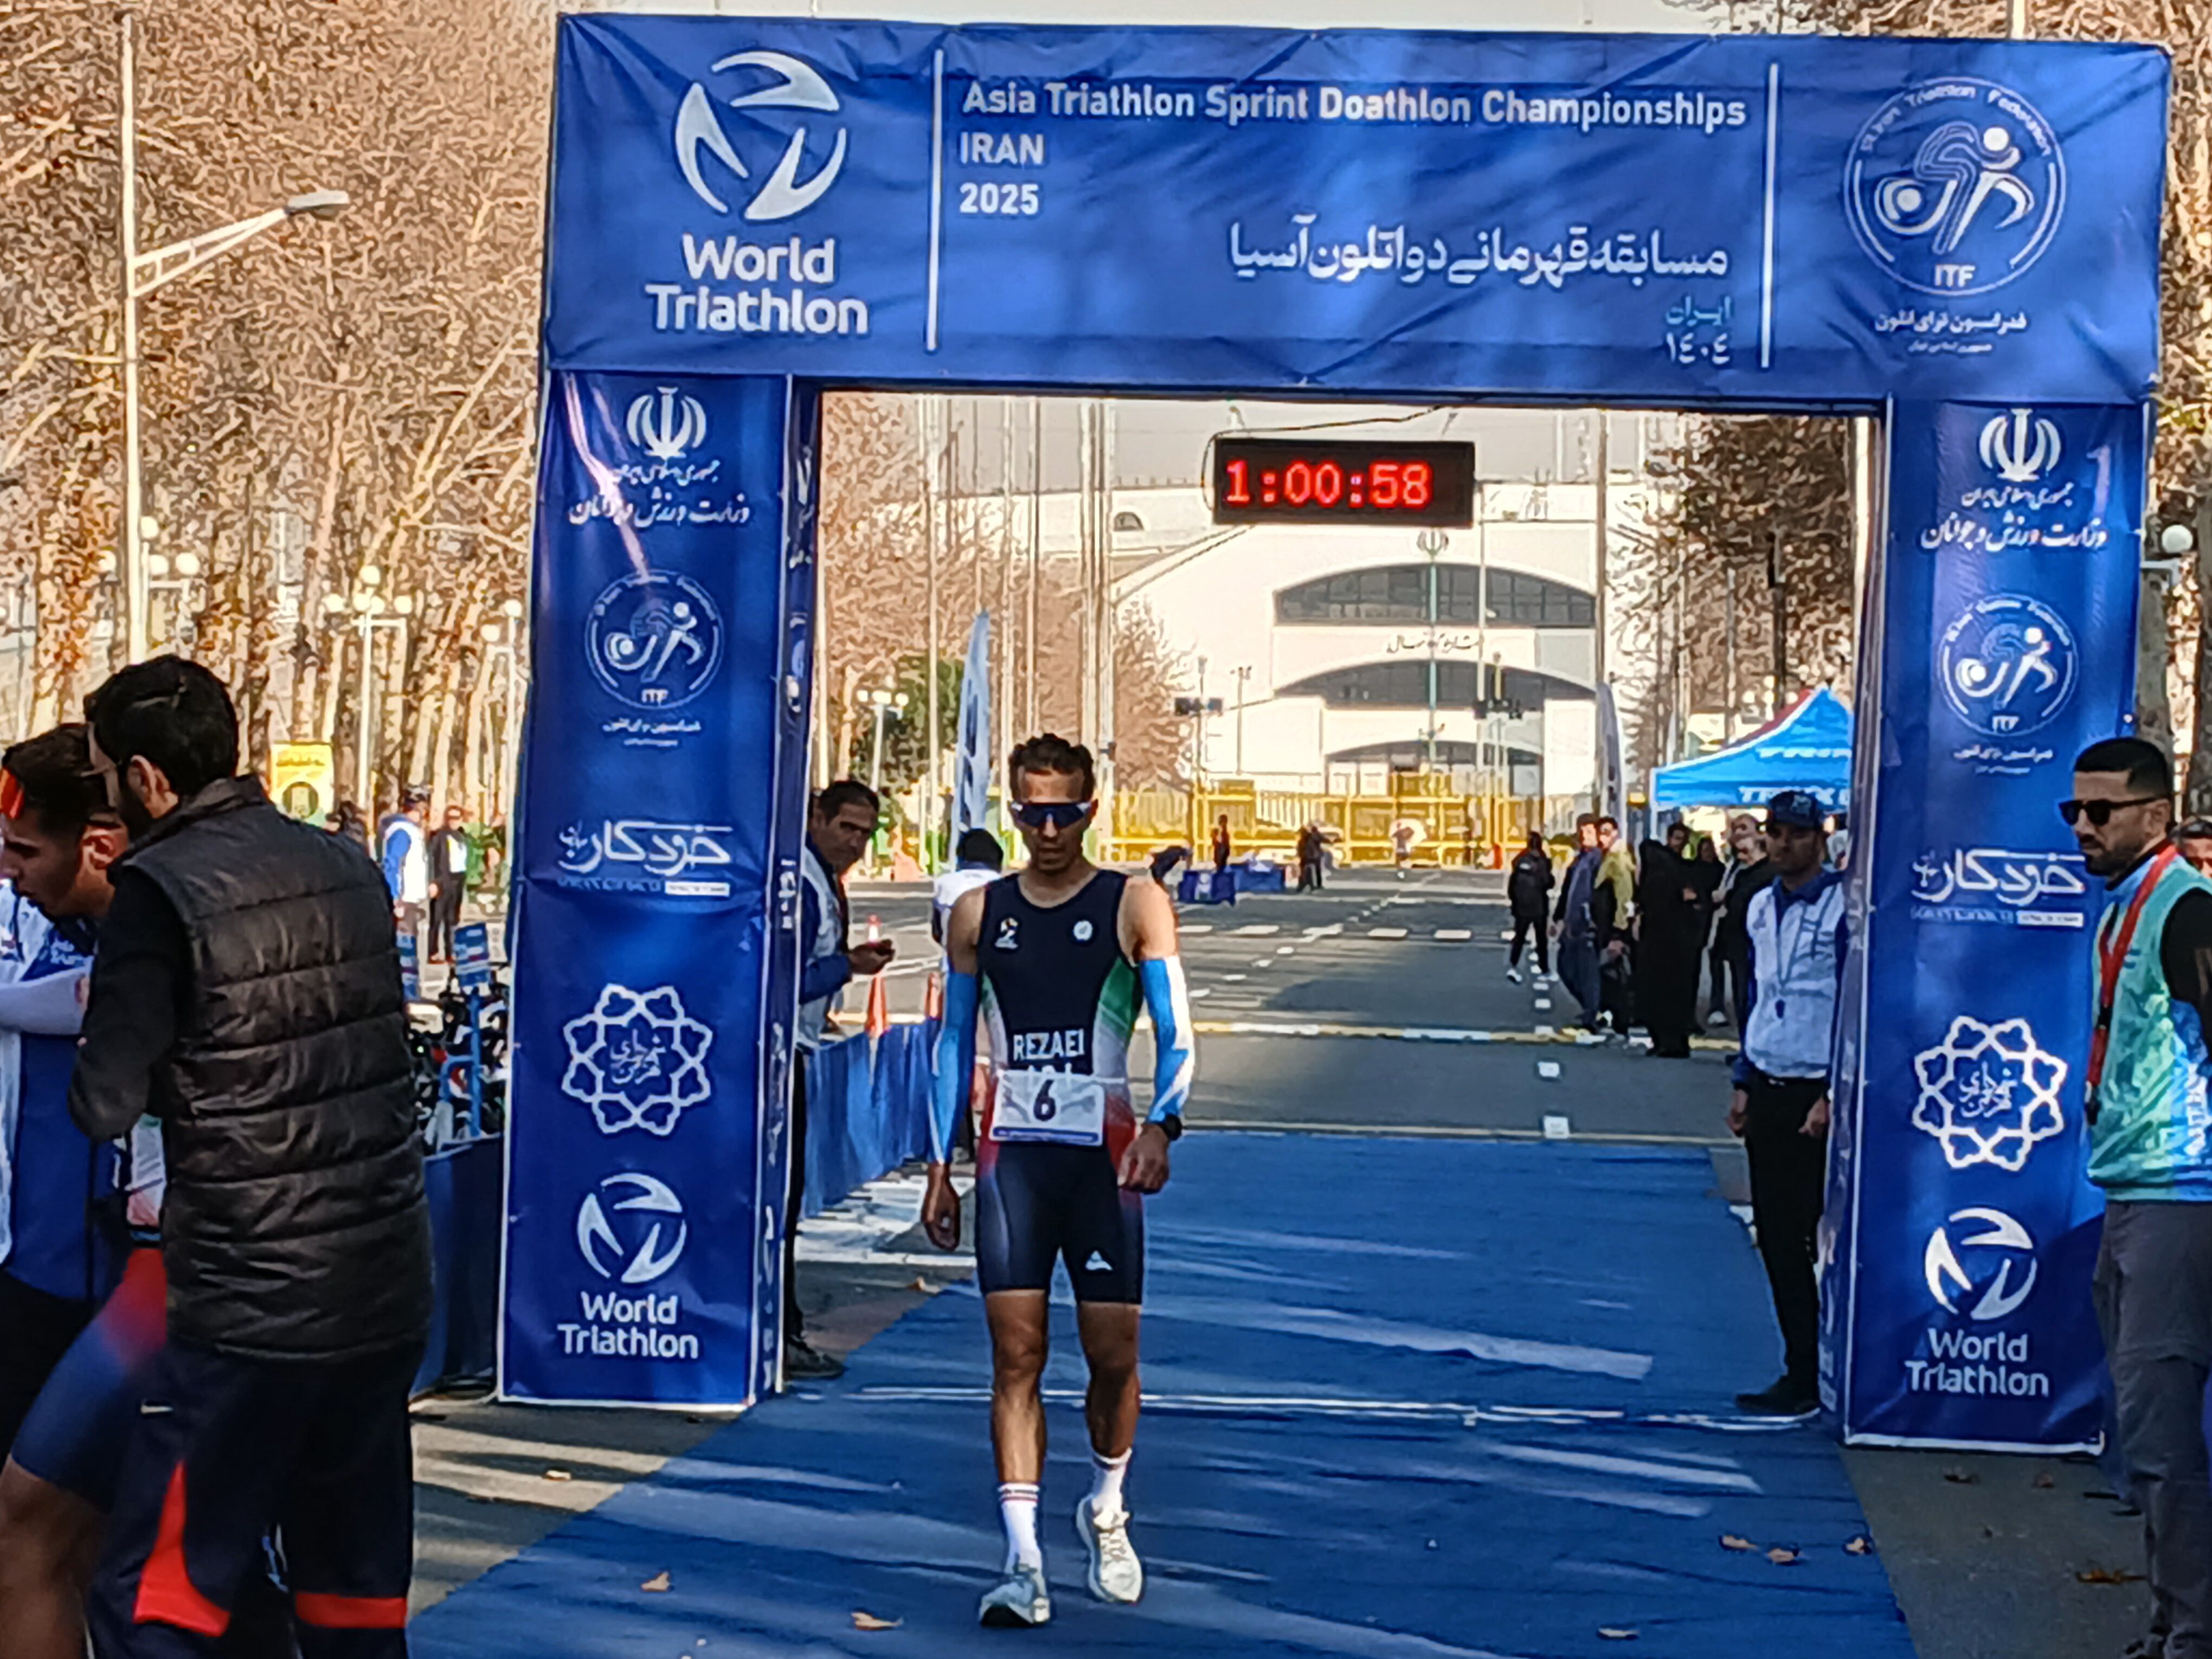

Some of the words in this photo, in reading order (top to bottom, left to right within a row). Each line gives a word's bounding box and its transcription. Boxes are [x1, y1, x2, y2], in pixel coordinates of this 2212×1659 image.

[963, 81, 1036, 113] Asia
[1044, 82, 1194, 117] Triathlon
[1205, 83, 1309, 126] Sprint
[1319, 87, 1471, 121] Doathlon
[1482, 89, 1747, 134] Championships
[960, 132, 1044, 164] IRAN
[959, 183, 1039, 214] 2025
[682, 233, 835, 284] World
[1231, 214, 1317, 278] آسیا
[1308, 224, 1447, 284] دواتلون
[1448, 227, 1588, 288] قهرمانی
[1589, 229, 1727, 286] مسابقه
[1934, 265, 1976, 286] ITF
[645, 284, 868, 334] Triathlon
[1665, 295, 1732, 326] ایران
[1224, 460, 1433, 509] 1:00:58
[1013, 1028, 1084, 1062] REZAEI
[1033, 1078, 1057, 1122] 6
[580, 1290, 679, 1324] World
[557, 1323, 699, 1359] Triathlon
[1927, 1328, 2028, 1361] World
[1904, 1360, 2049, 1396] Triathlon
